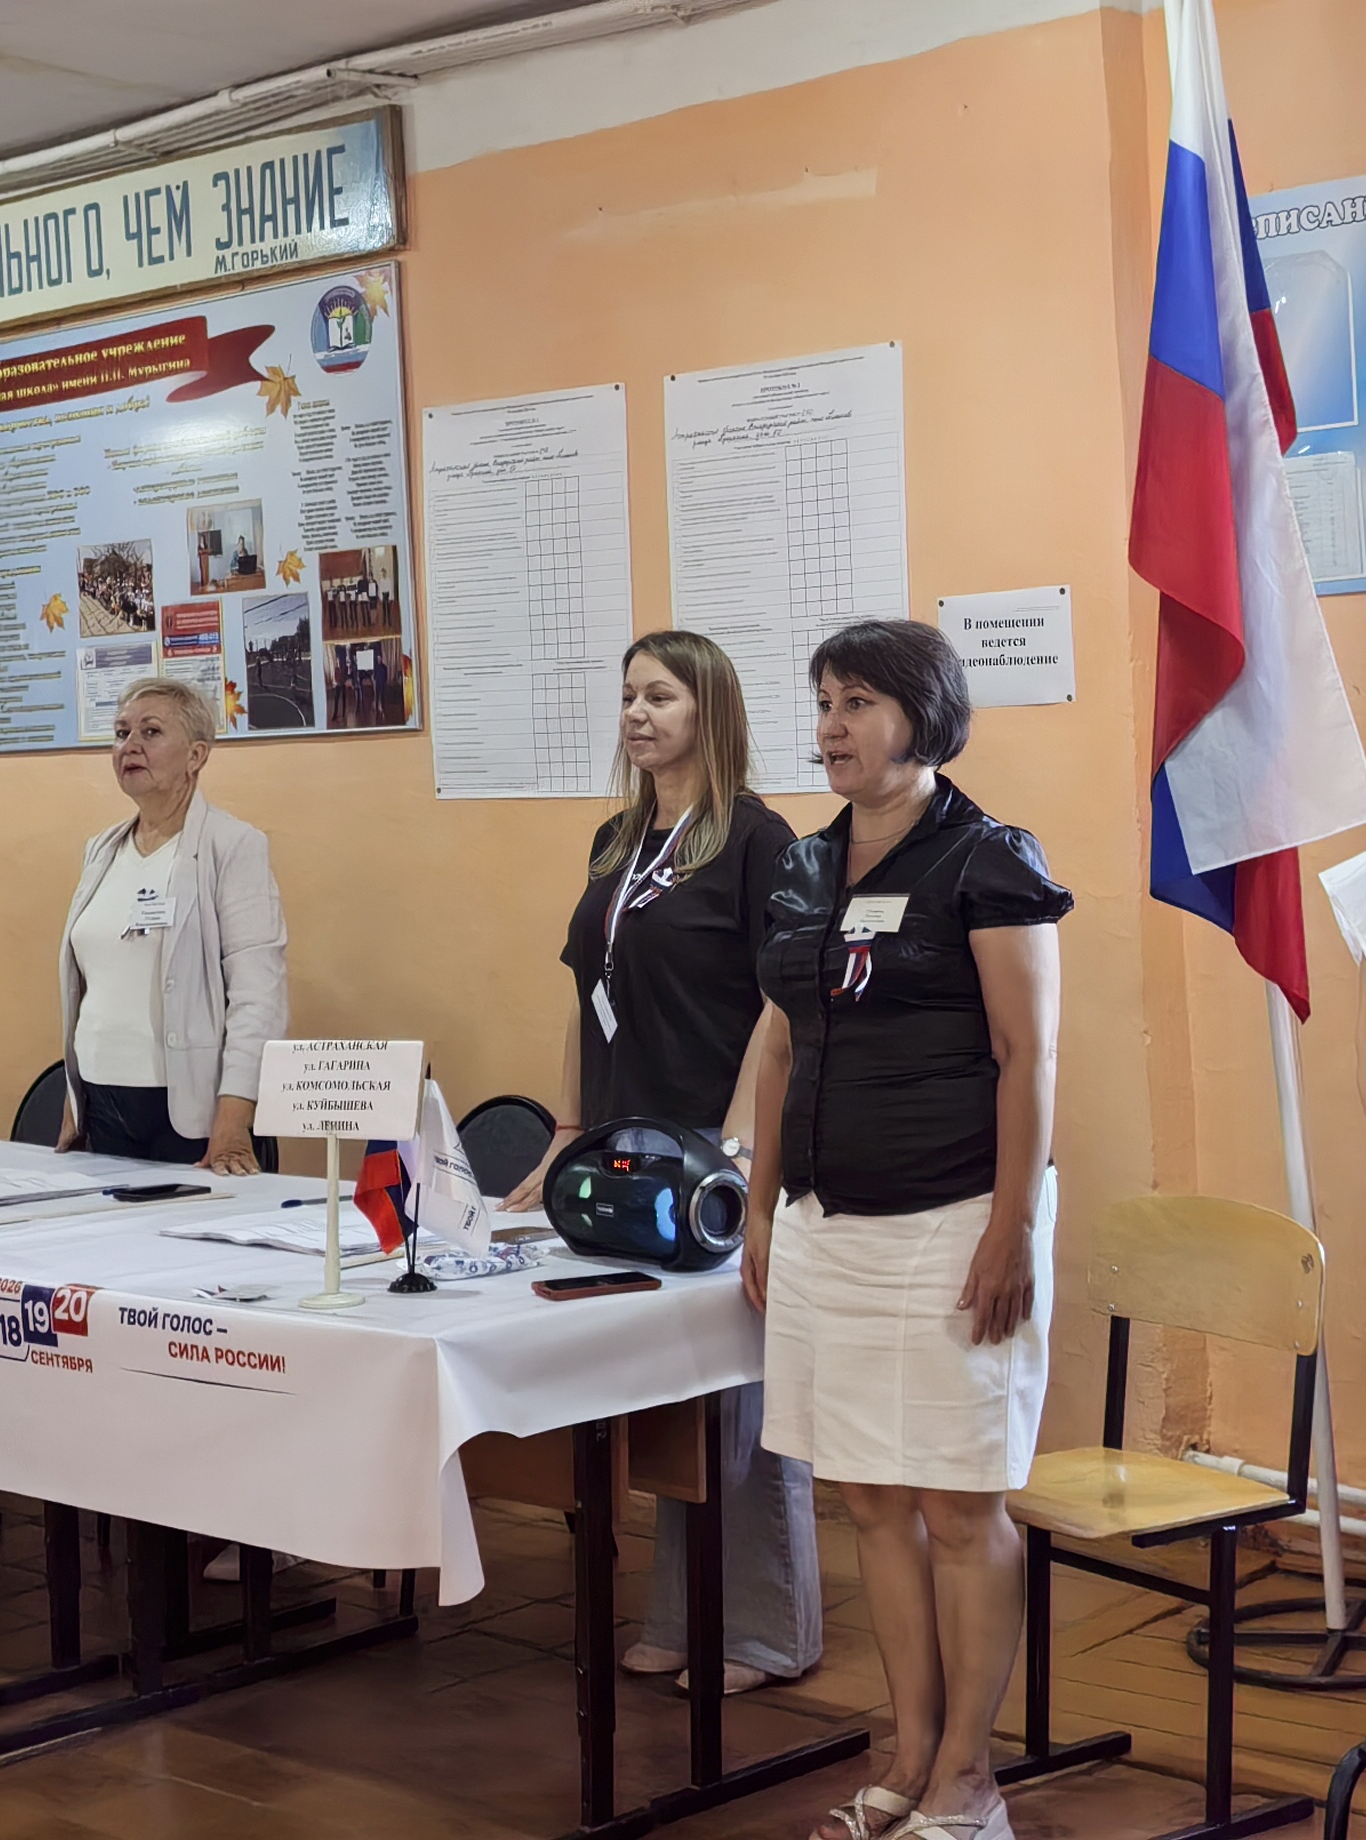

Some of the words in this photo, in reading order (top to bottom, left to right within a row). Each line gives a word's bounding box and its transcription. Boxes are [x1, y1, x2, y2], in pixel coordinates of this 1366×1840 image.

[123, 179, 192, 268] ЧЕМ
[212, 144, 350, 251] ЗНАНИЕ
[101, 334, 186, 362] учреждение
[964, 617, 972, 630] В
[975, 617, 1045, 631] помещении
[981, 637, 1027, 649] ведется
[959, 654, 1059, 668] деонаблюдение
[307, 1040, 389, 1051] АСТРАХАНСКАЯ
[318, 1060, 371, 1071] ГАГАРИНА
[296, 1080, 392, 1092] КОМСОМОЛЬСКАЯ
[306, 1098, 374, 1111] КУЙБЫШЕВА
[316, 1120, 360, 1132] ЛЕНИНА
[24, 1299, 50, 1334] 19
[54, 1288, 86, 1322] 20
[118, 1306, 158, 1329] ТВОЙ
[161, 1313, 214, 1336] ГОЛОС
[30, 1349, 94, 1374] СЕНТЯБРЯ
[168, 1341, 211, 1364] СИЛА
[215, 1347, 286, 1374] РОССИИ!
